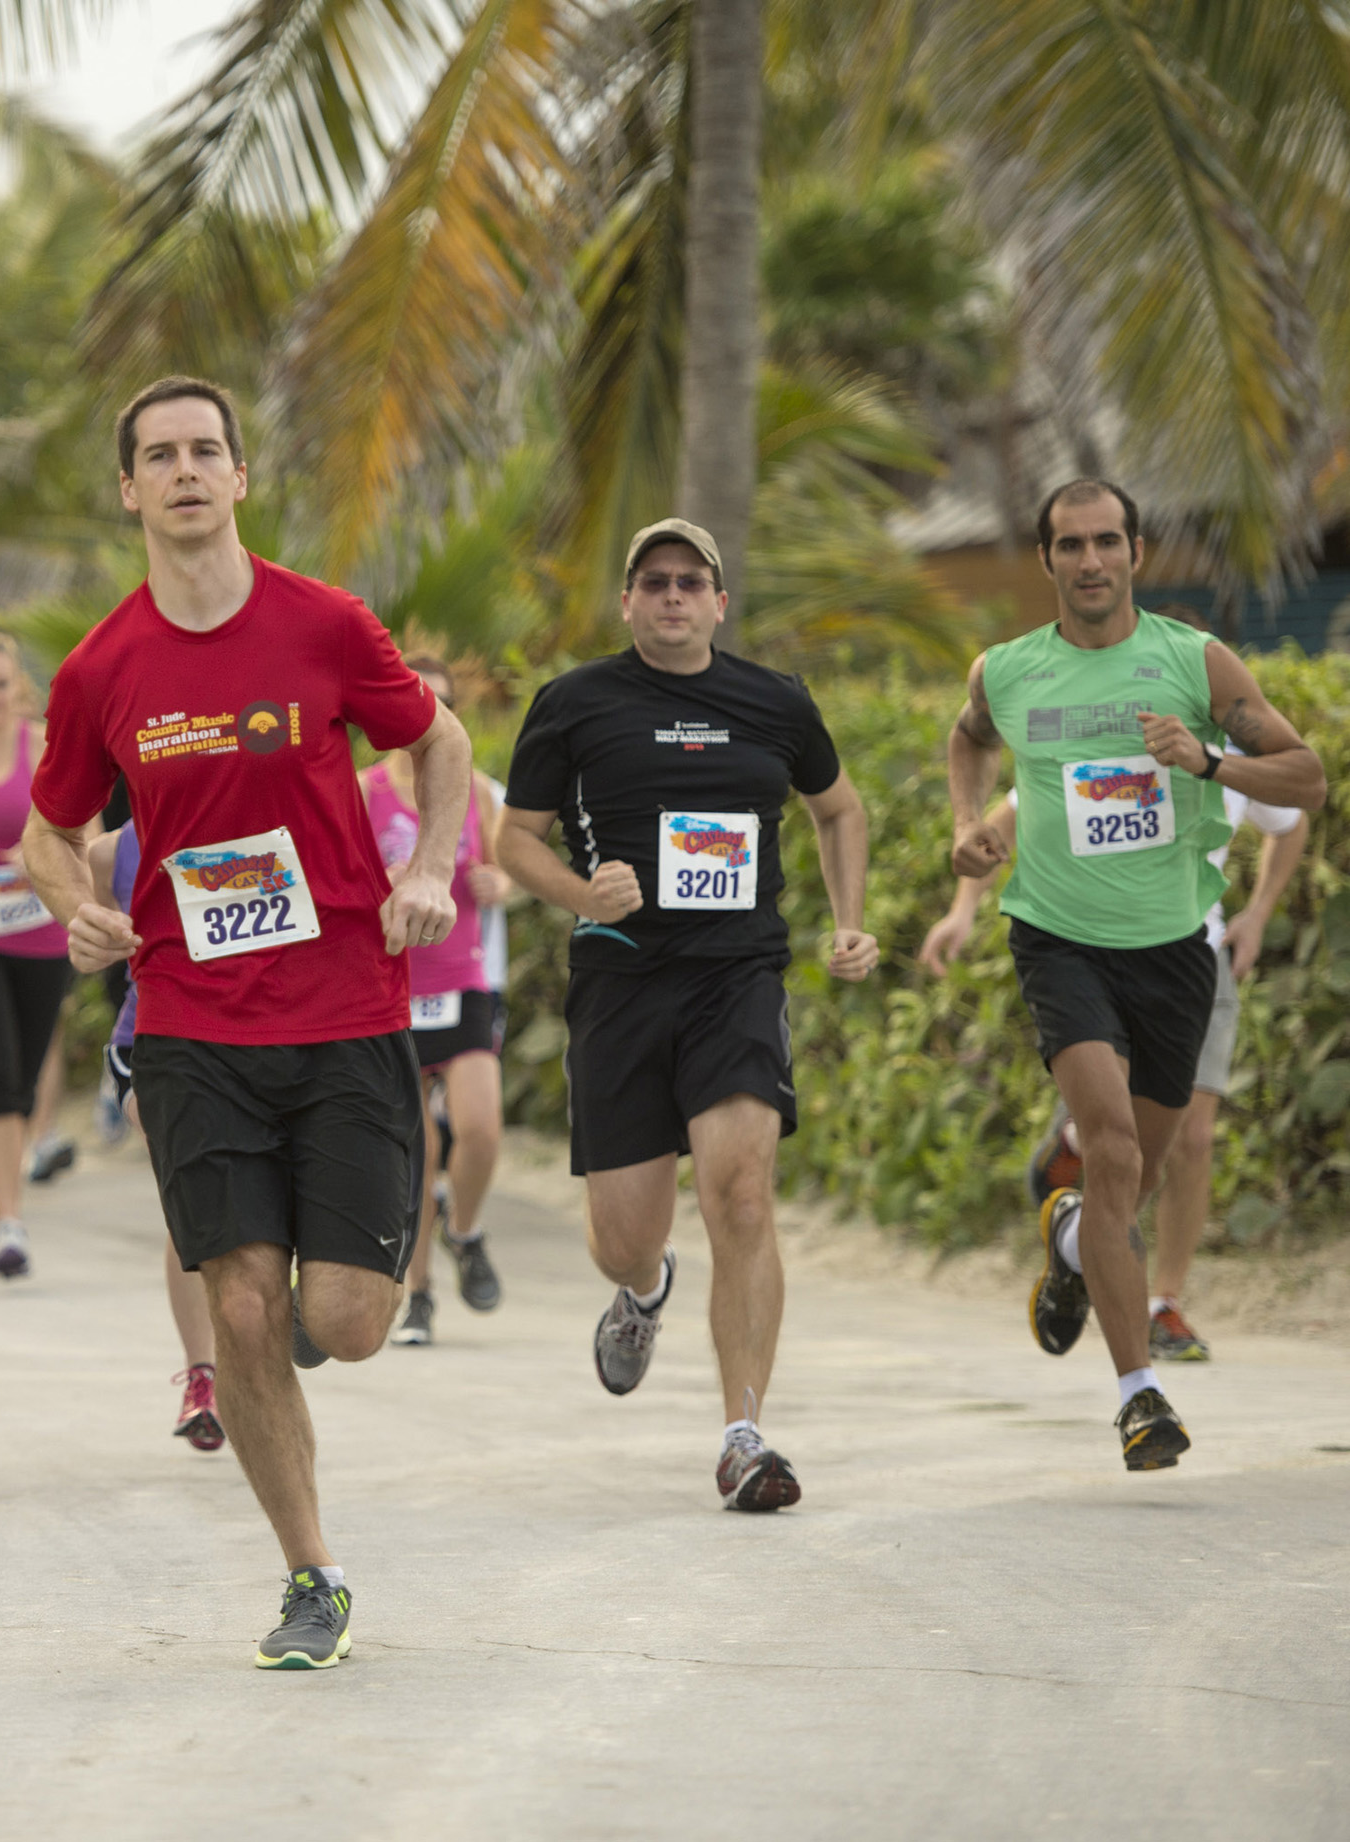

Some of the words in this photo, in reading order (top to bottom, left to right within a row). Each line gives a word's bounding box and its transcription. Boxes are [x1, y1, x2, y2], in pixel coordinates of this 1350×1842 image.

[136, 721, 191, 743] Country
[191, 712, 235, 730] Music
[147, 716, 160, 728] St.
[160, 711, 186, 725] Jude
[289, 707, 302, 746] 2012
[138, 727, 222, 753] marathon
[139, 749, 160, 763] 1/2
[161, 735, 238, 757] marathon
[208, 744, 239, 755] NISSAN
[1140, 789, 1160, 808] 5K
[1086, 809, 1160, 845] 3253
[683, 829, 746, 855] Castaway
[198, 851, 277, 892] Castaway
[729, 851, 747, 867] 5K
[232, 873, 260, 889] CAY
[261, 872, 290, 894] 5K
[676, 868, 740, 899] 3201
[203, 894, 297, 946] 3222
